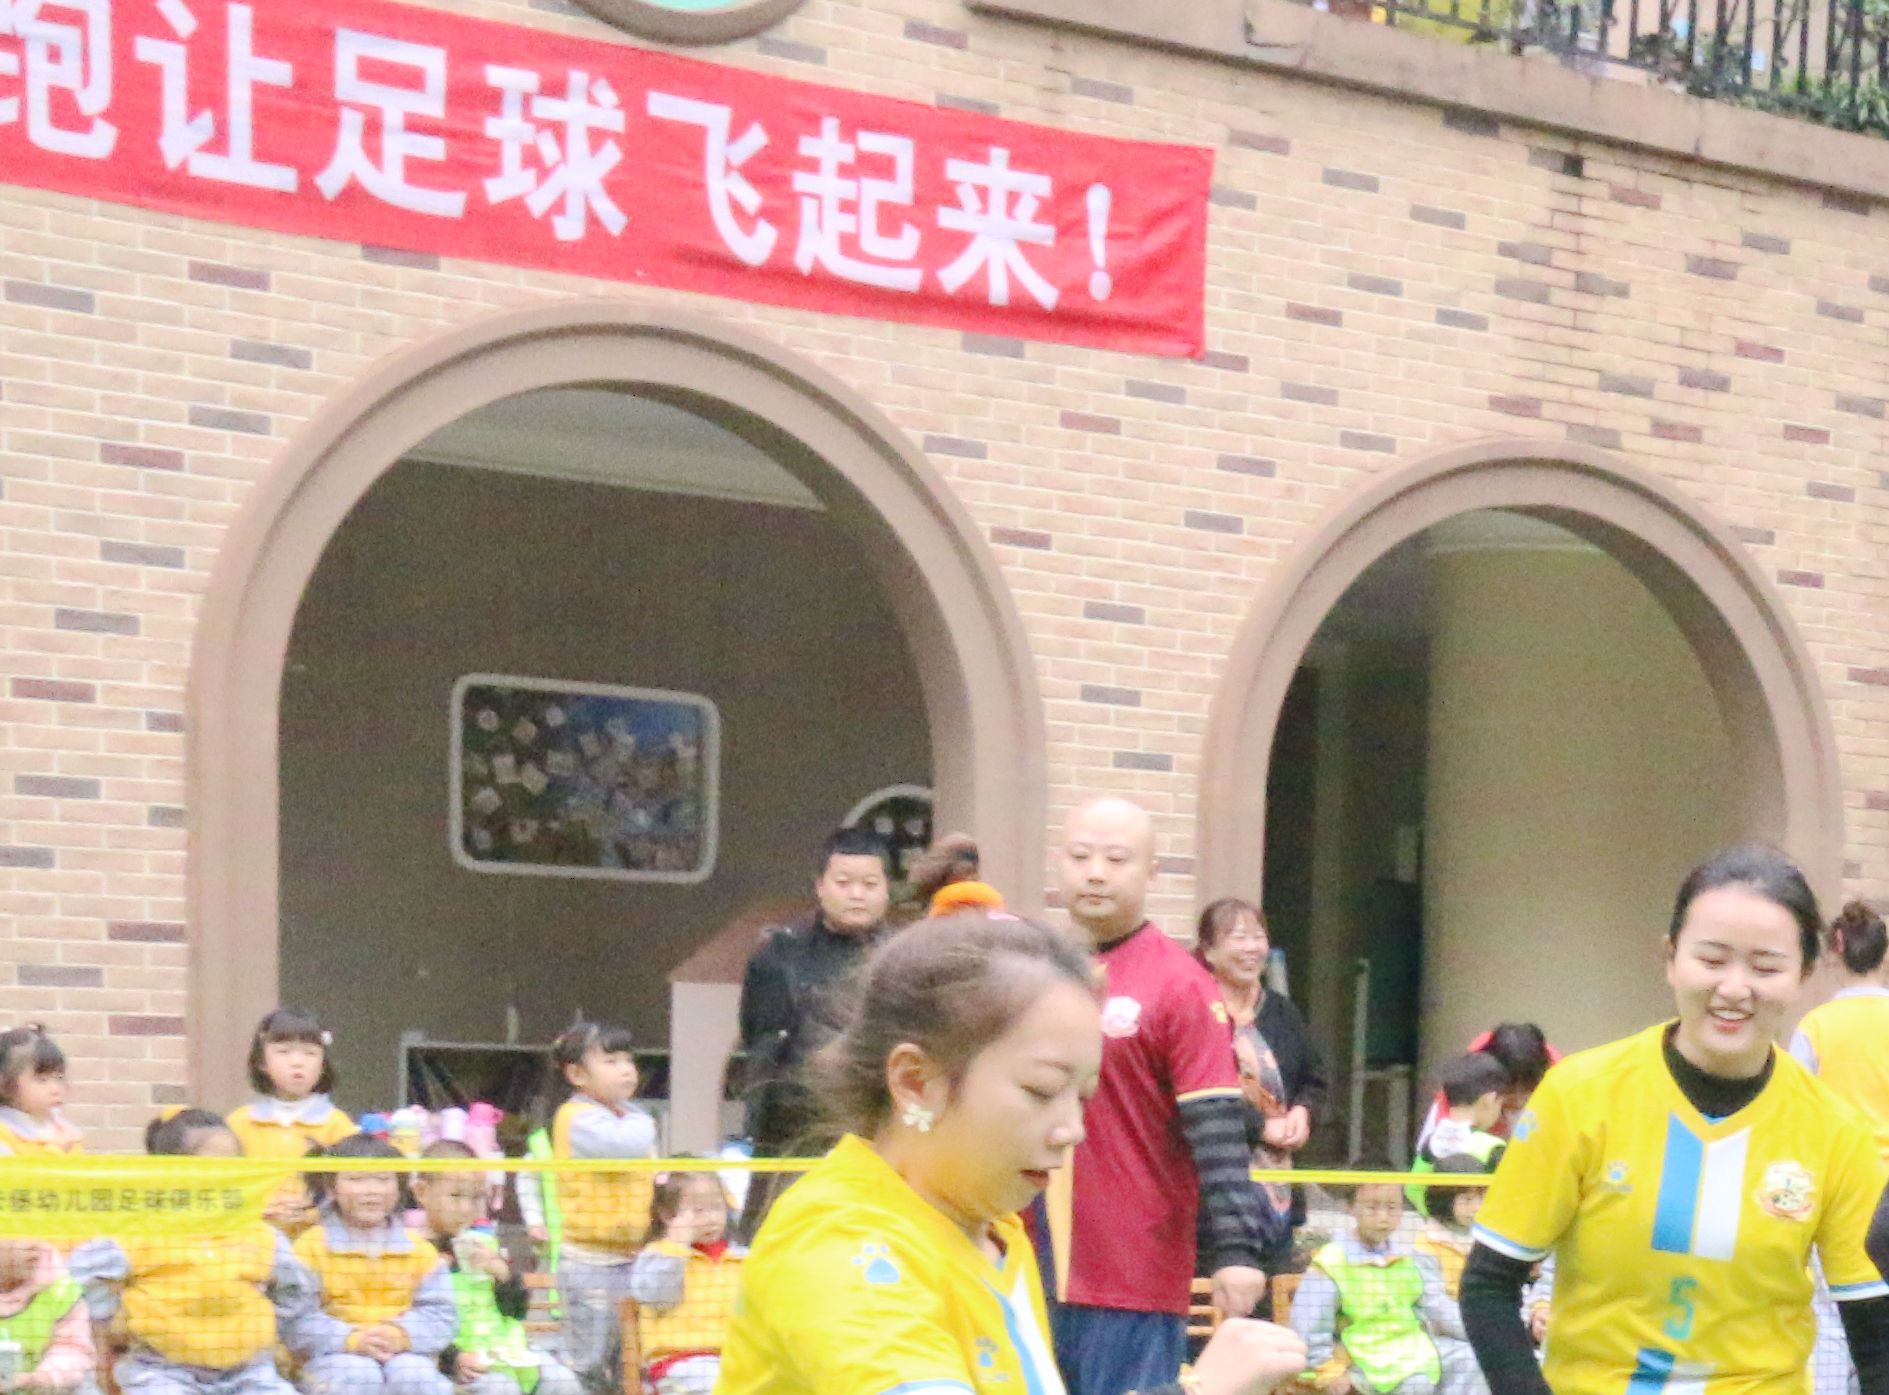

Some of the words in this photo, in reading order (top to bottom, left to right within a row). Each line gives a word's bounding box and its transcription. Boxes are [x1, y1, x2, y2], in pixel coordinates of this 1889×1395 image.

[0, 1187, 244, 1213] 堡幼儿园足球俱乐部
[1663, 1275, 1697, 1341] 5
